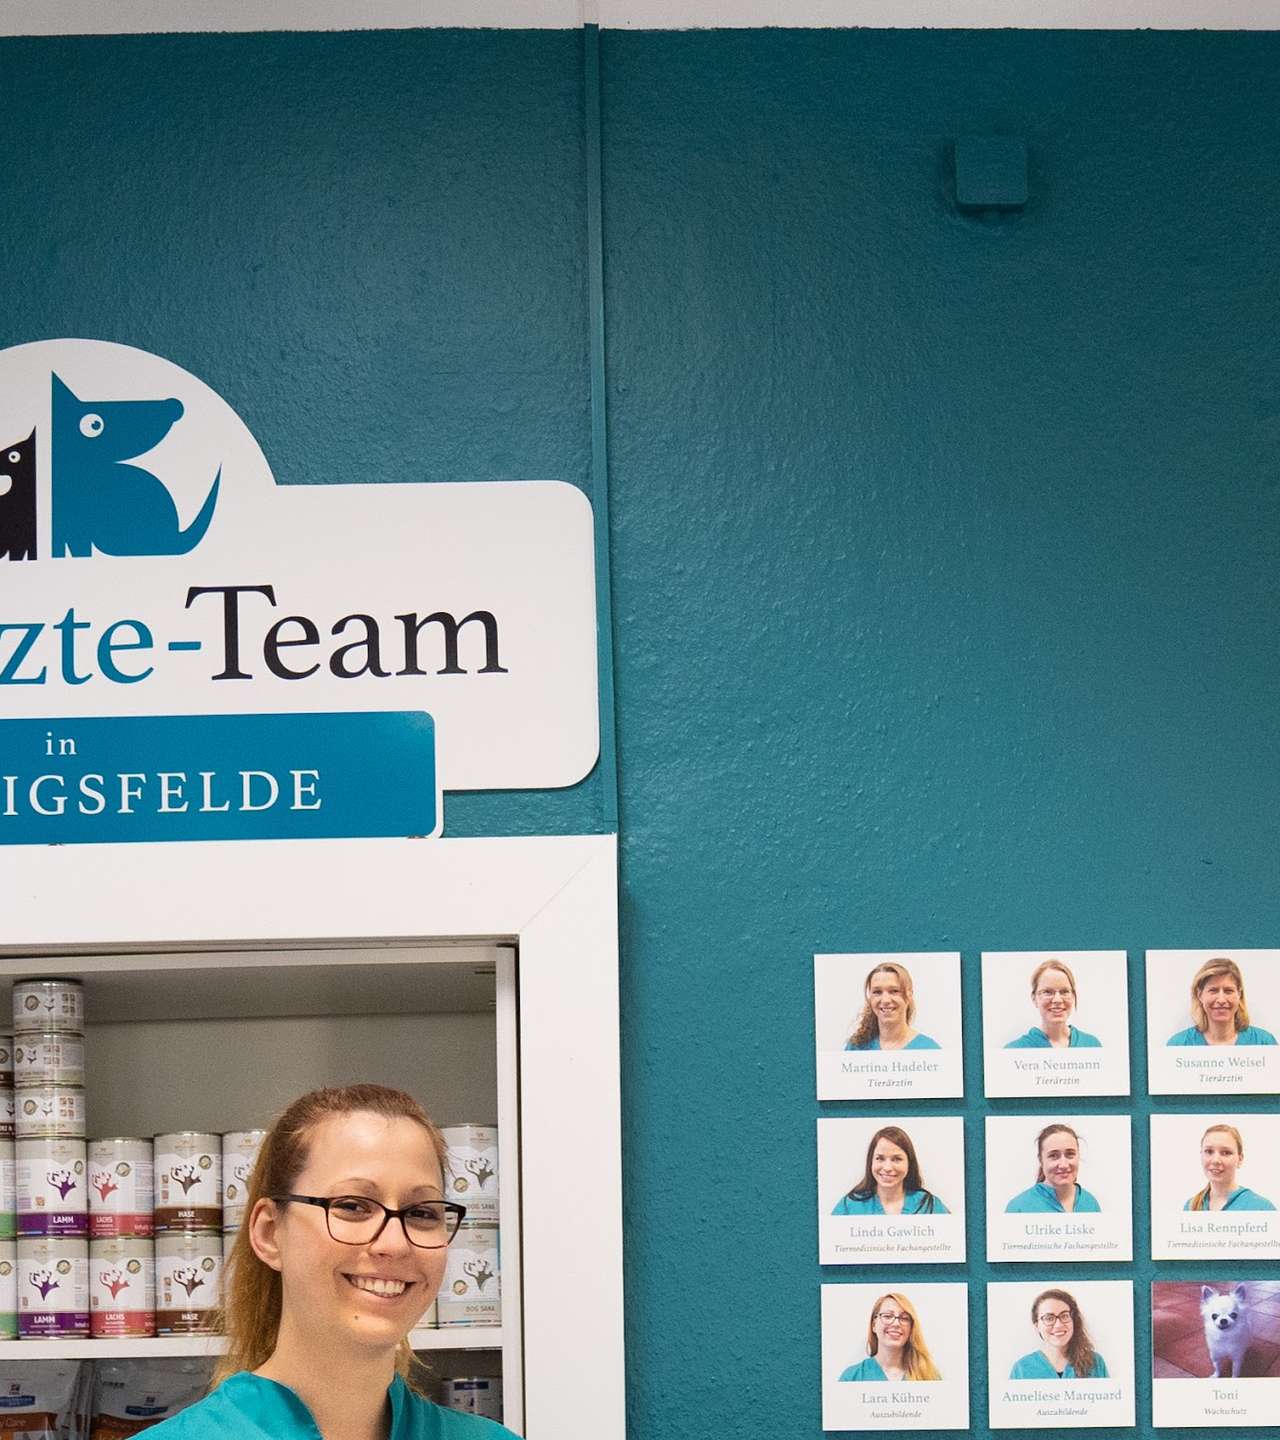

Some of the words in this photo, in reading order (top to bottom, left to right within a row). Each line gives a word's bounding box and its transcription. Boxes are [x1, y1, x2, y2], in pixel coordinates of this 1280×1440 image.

[46, 733, 77, 757] in
[841, 1061, 888, 1073] Martina
[891, 1060, 939, 1072] Hadeler
[1014, 1059, 1040, 1071] Vera
[1043, 1058, 1100, 1070] Neumann
[1176, 1057, 1224, 1068] Susanne
[1228, 1056, 1265, 1068] Weisel
[867, 1077, 913, 1088] Tierärztin
[1035, 1075, 1080, 1086] Tierärztin
[1200, 1072, 1243, 1084] Tierärztin
[52, 1216, 74, 1224] LAMM
[850, 1224, 884, 1237] Linda
[887, 1224, 935, 1240] Gawlich
[1025, 1223, 1061, 1235] Ulrike
[1064, 1223, 1095, 1235] Liske
[1180, 1221, 1203, 1233] Lisa
[1207, 1221, 1268, 1235] Rennpferd
[33, 1315, 56, 1324] LAMM
[862, 1392, 887, 1404] Lara
[890, 1391, 930, 1404] Kühne
[1002, 1389, 1061, 1401] Anneliese
[1064, 1388, 1122, 1403] Marquard
[1212, 1389, 1239, 1400] Toni
